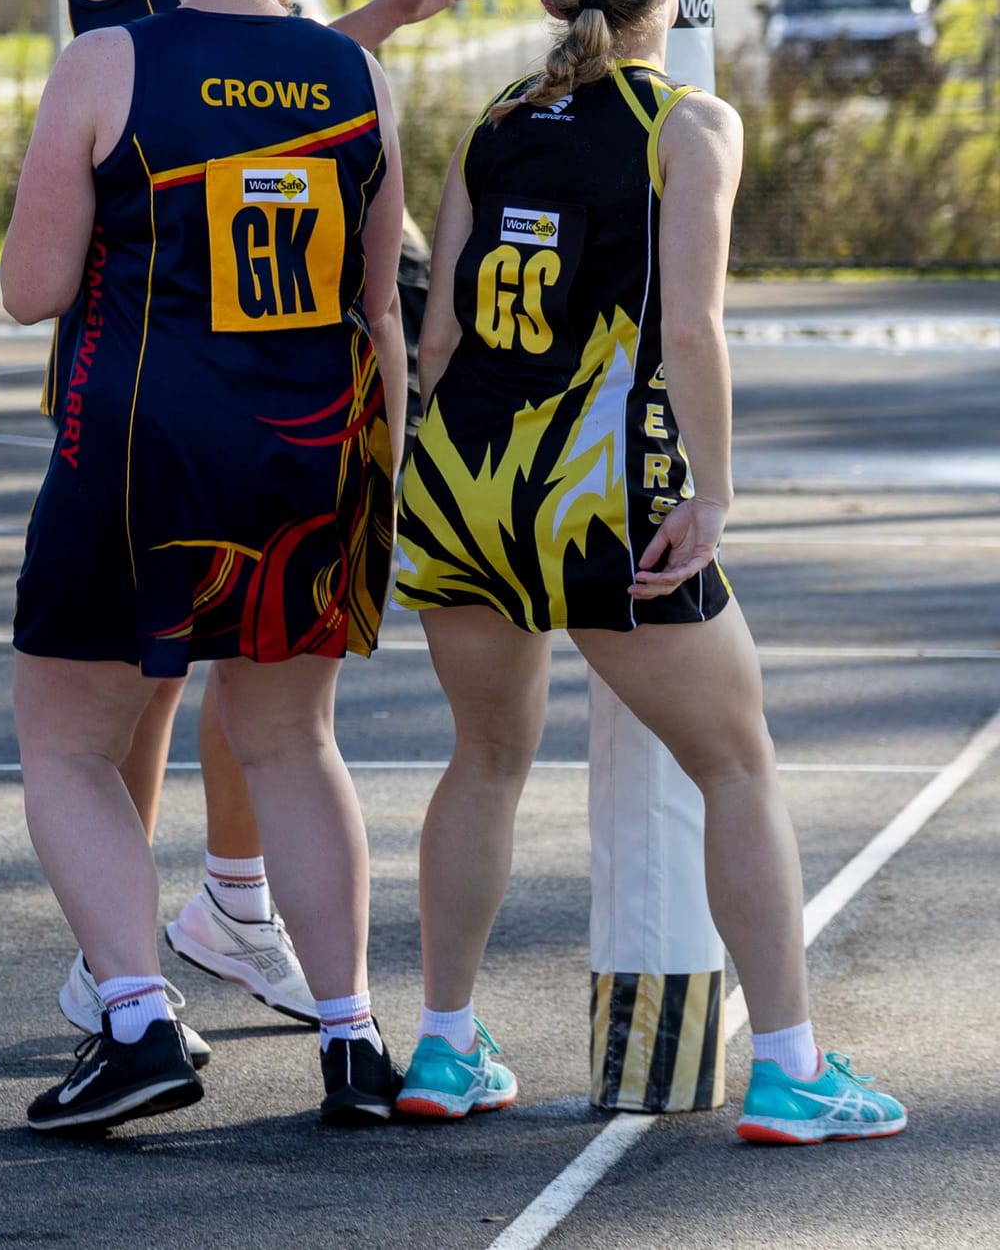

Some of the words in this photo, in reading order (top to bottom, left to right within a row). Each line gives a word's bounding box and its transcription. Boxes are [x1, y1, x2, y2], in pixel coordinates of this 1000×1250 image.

[200, 77, 331, 111] CROWS
[249, 179, 302, 191] WorkSafe
[231, 205, 319, 320] GK
[475, 244, 561, 354] GS
[61, 225, 107, 469] ONGWARRY
